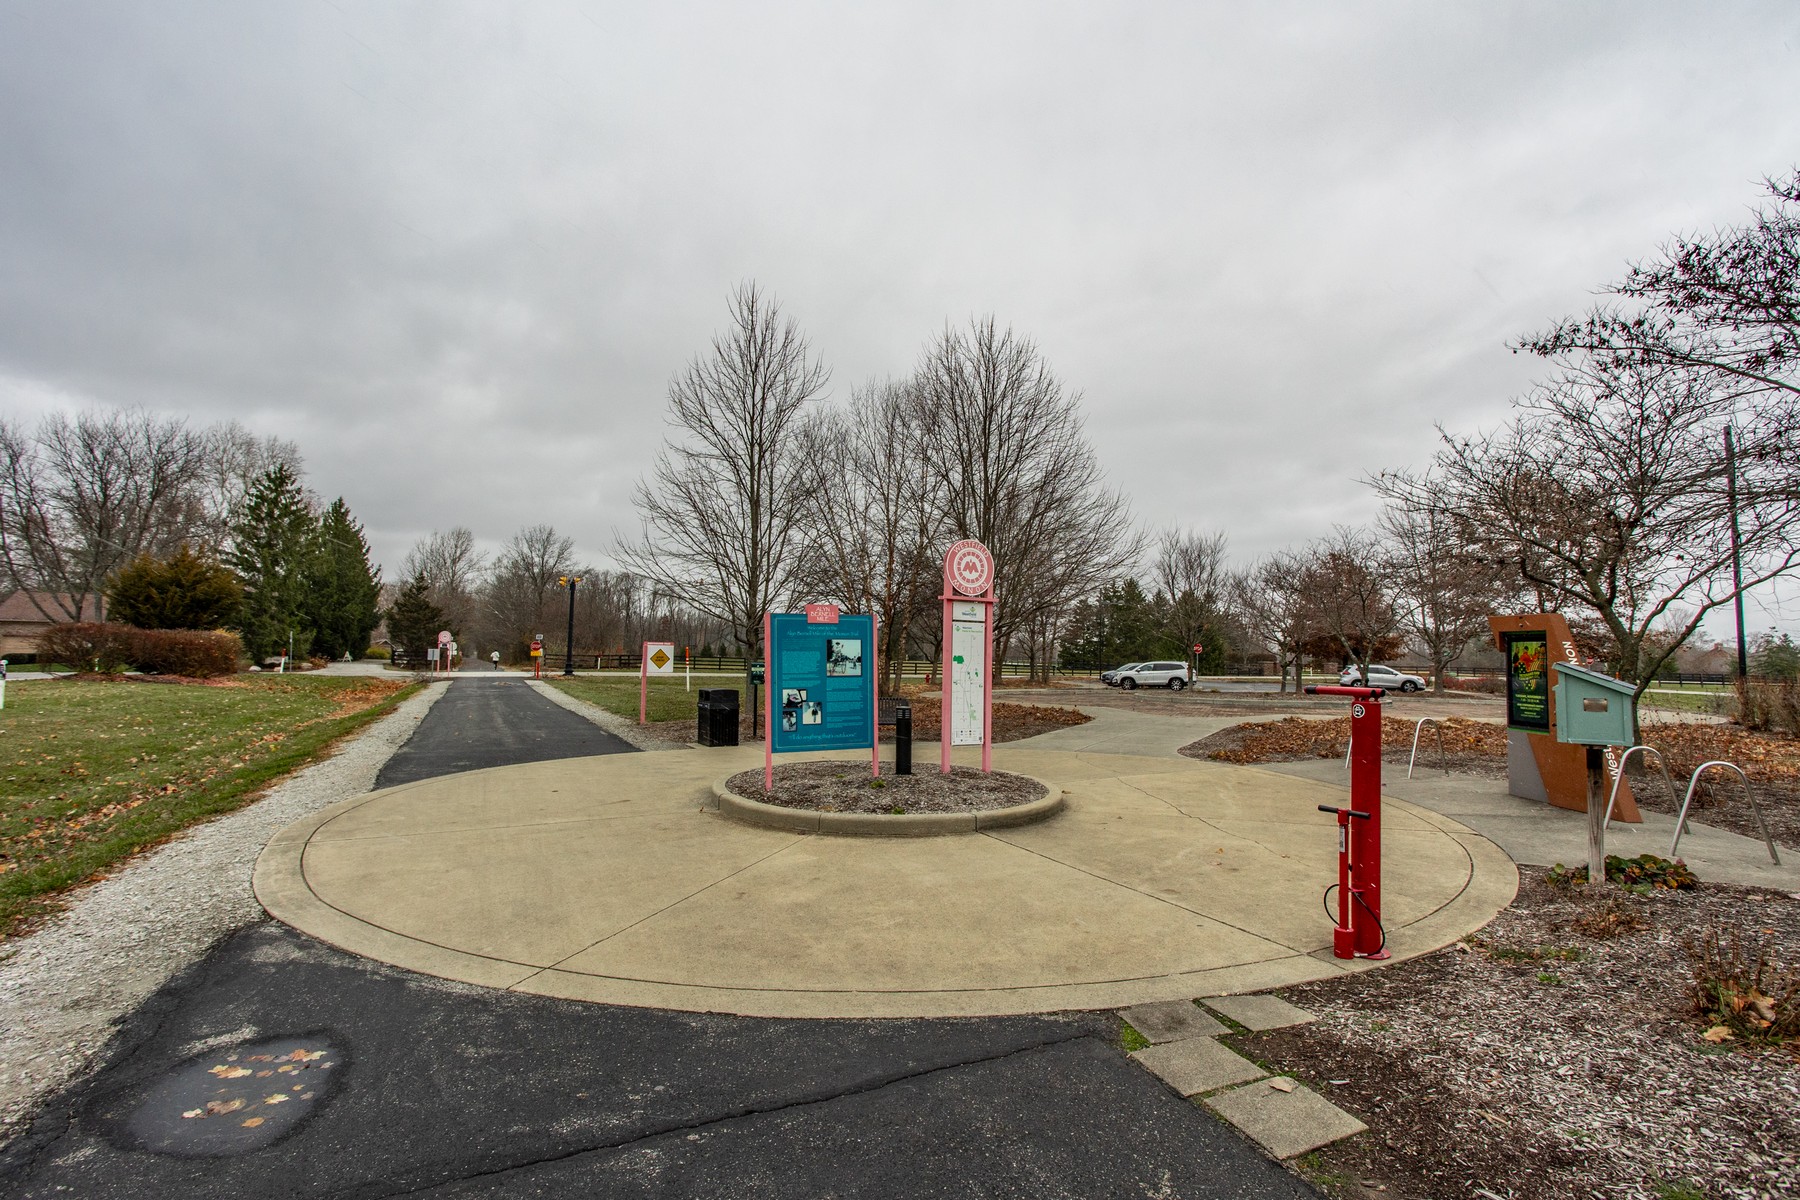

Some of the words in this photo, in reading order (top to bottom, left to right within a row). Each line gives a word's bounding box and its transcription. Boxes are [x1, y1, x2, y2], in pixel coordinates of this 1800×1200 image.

[954, 541, 988, 557] WESTFIELD
[953, 579, 988, 593] MONON
[1562, 641, 1580, 665] NON
